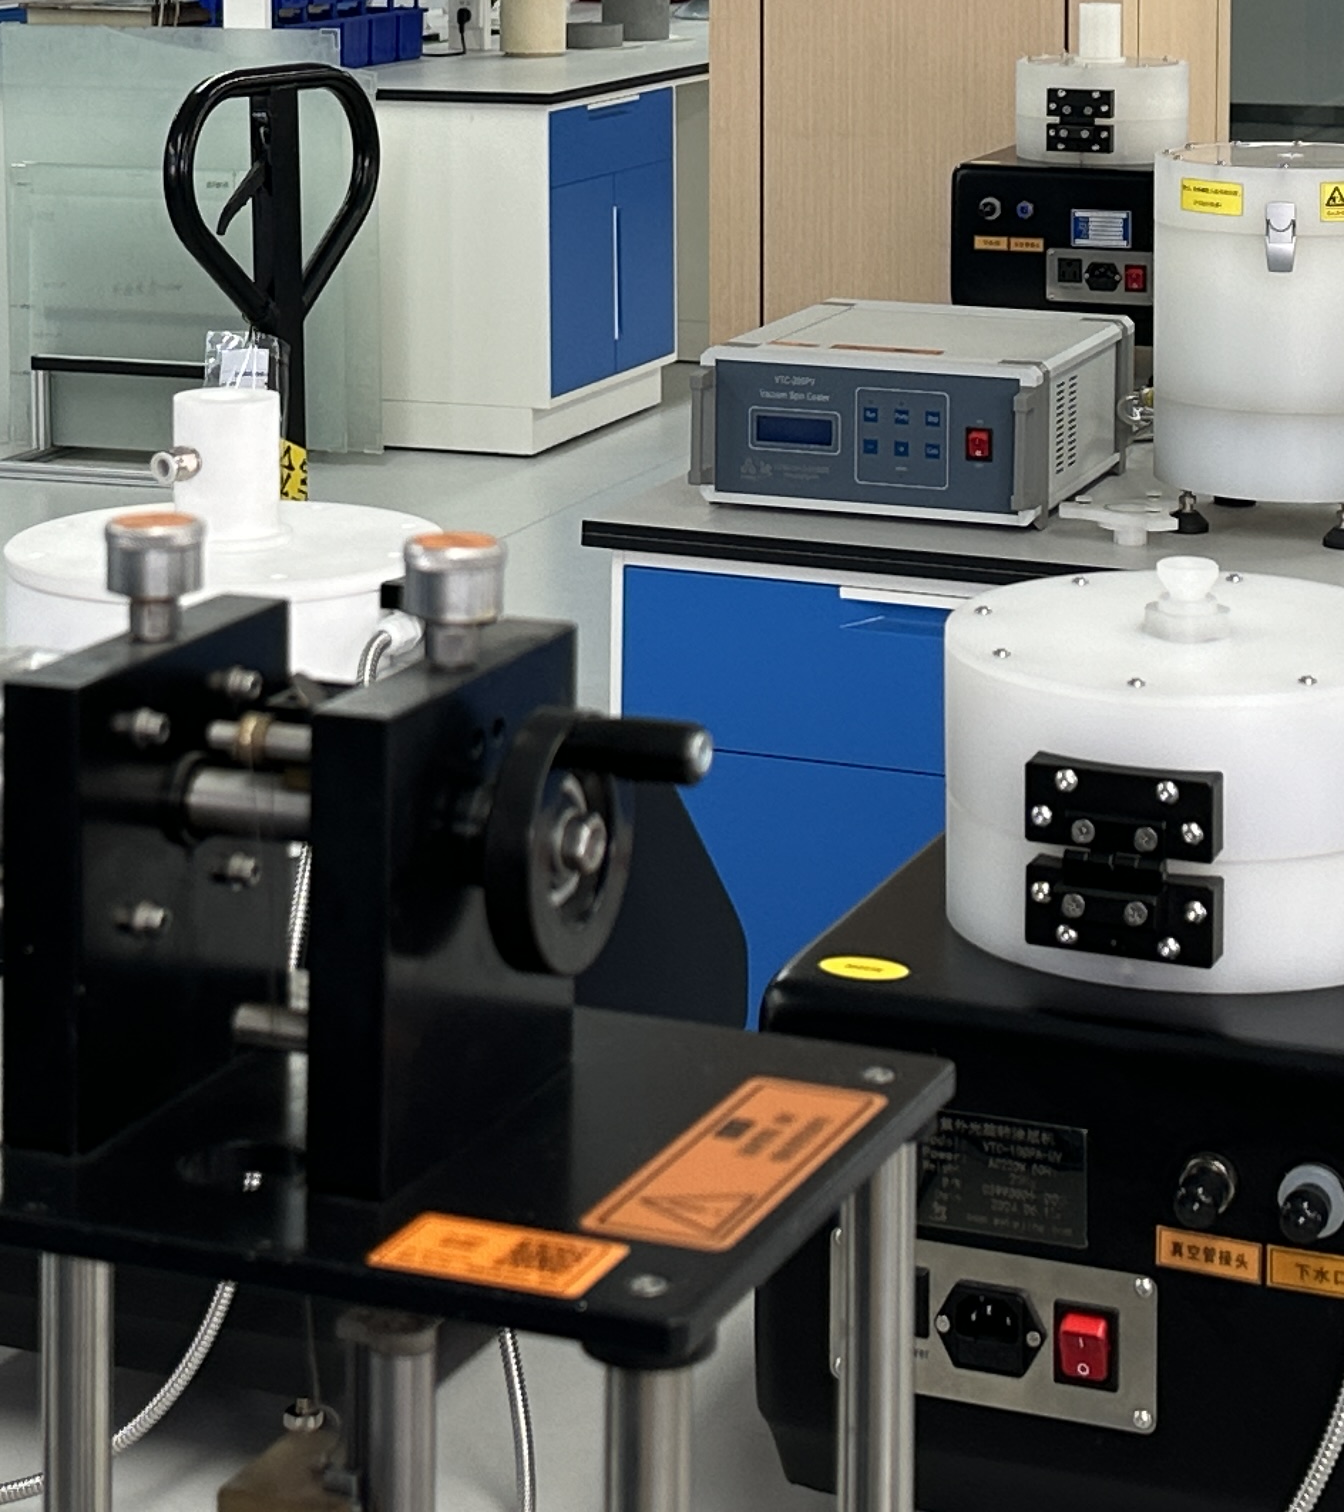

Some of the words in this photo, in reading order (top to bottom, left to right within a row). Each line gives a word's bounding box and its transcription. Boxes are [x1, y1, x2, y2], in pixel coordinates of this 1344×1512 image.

[1170, 1241, 1249, 1270] 真空管接头
